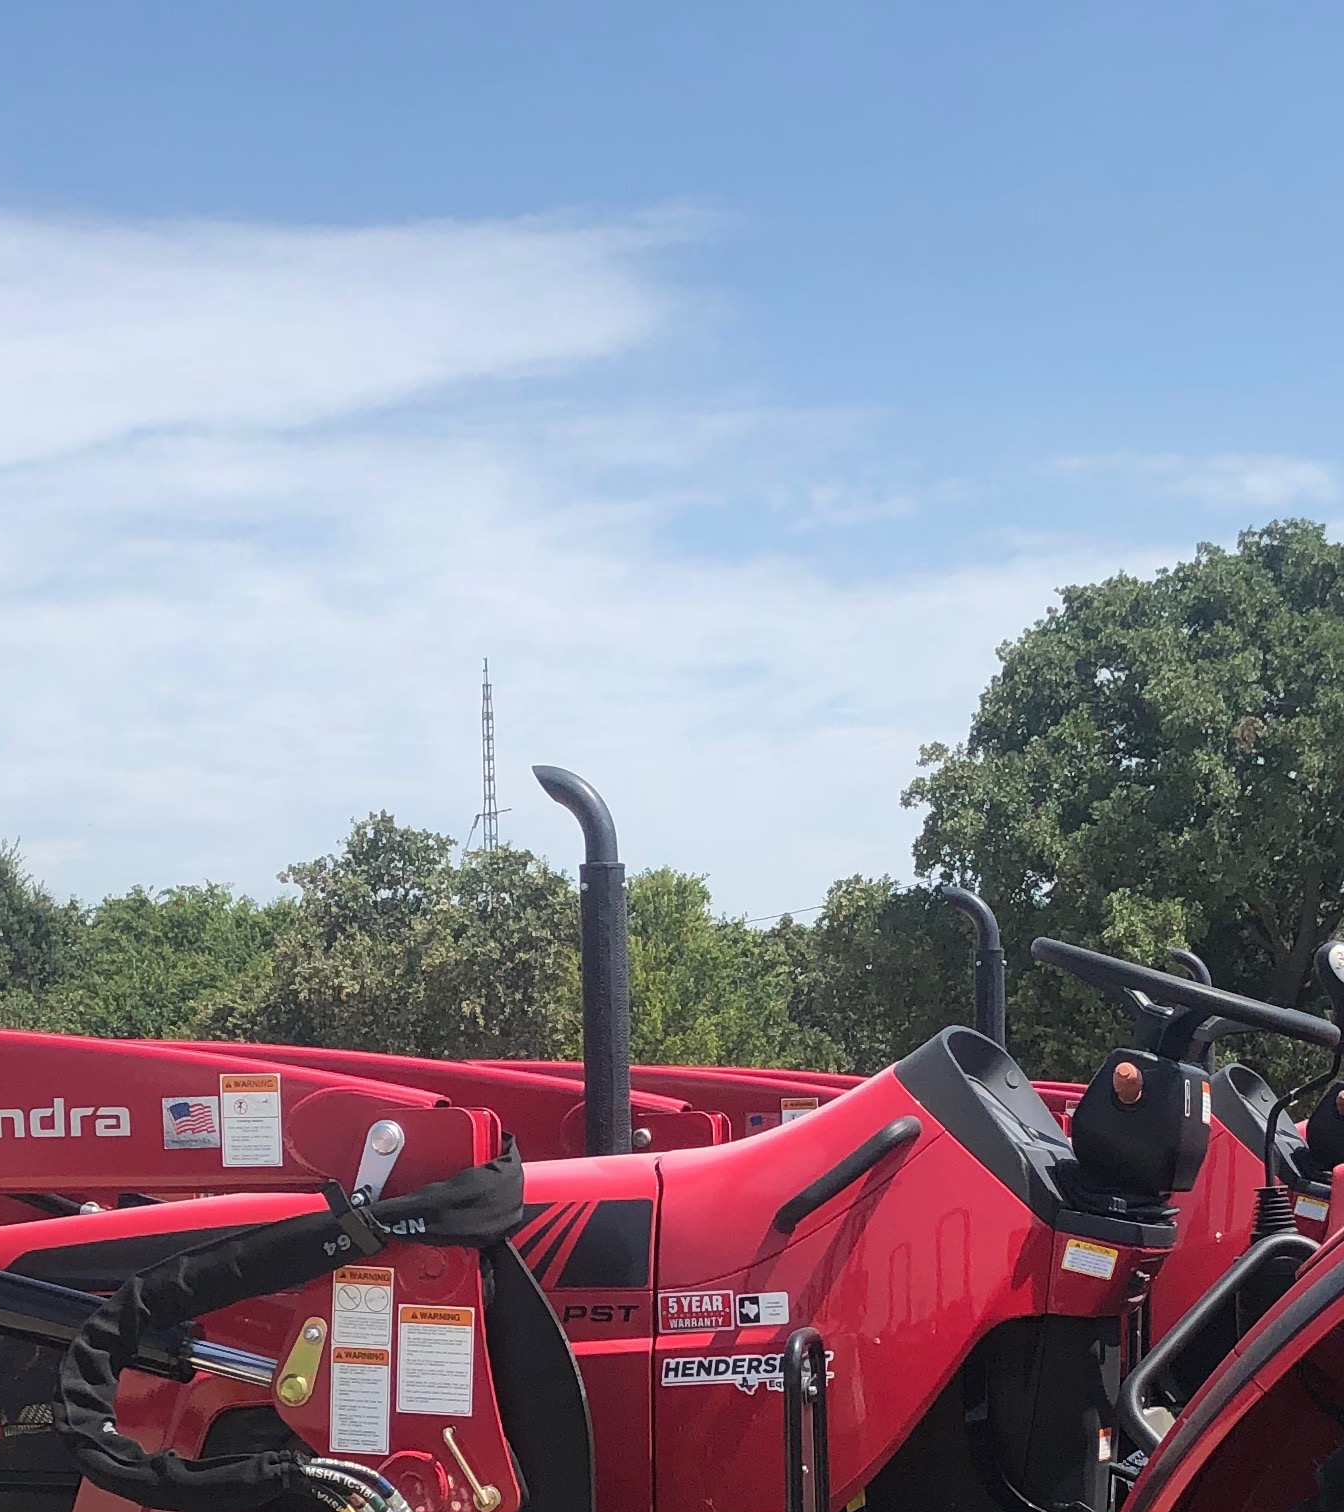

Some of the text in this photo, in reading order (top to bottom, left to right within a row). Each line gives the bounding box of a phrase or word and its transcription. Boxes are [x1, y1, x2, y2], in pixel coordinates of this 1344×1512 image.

[233, 1079, 274, 1089] WARNING
[349, 1271, 391, 1282] WARNING
[668, 1297, 678, 1314] 5
[680, 1295, 723, 1313] YEAR
[419, 1311, 461, 1322] WARNING
[562, 1304, 640, 1323] PST
[669, 1316, 724, 1329] WARRANTY
[344, 1350, 386, 1361] WARNING
